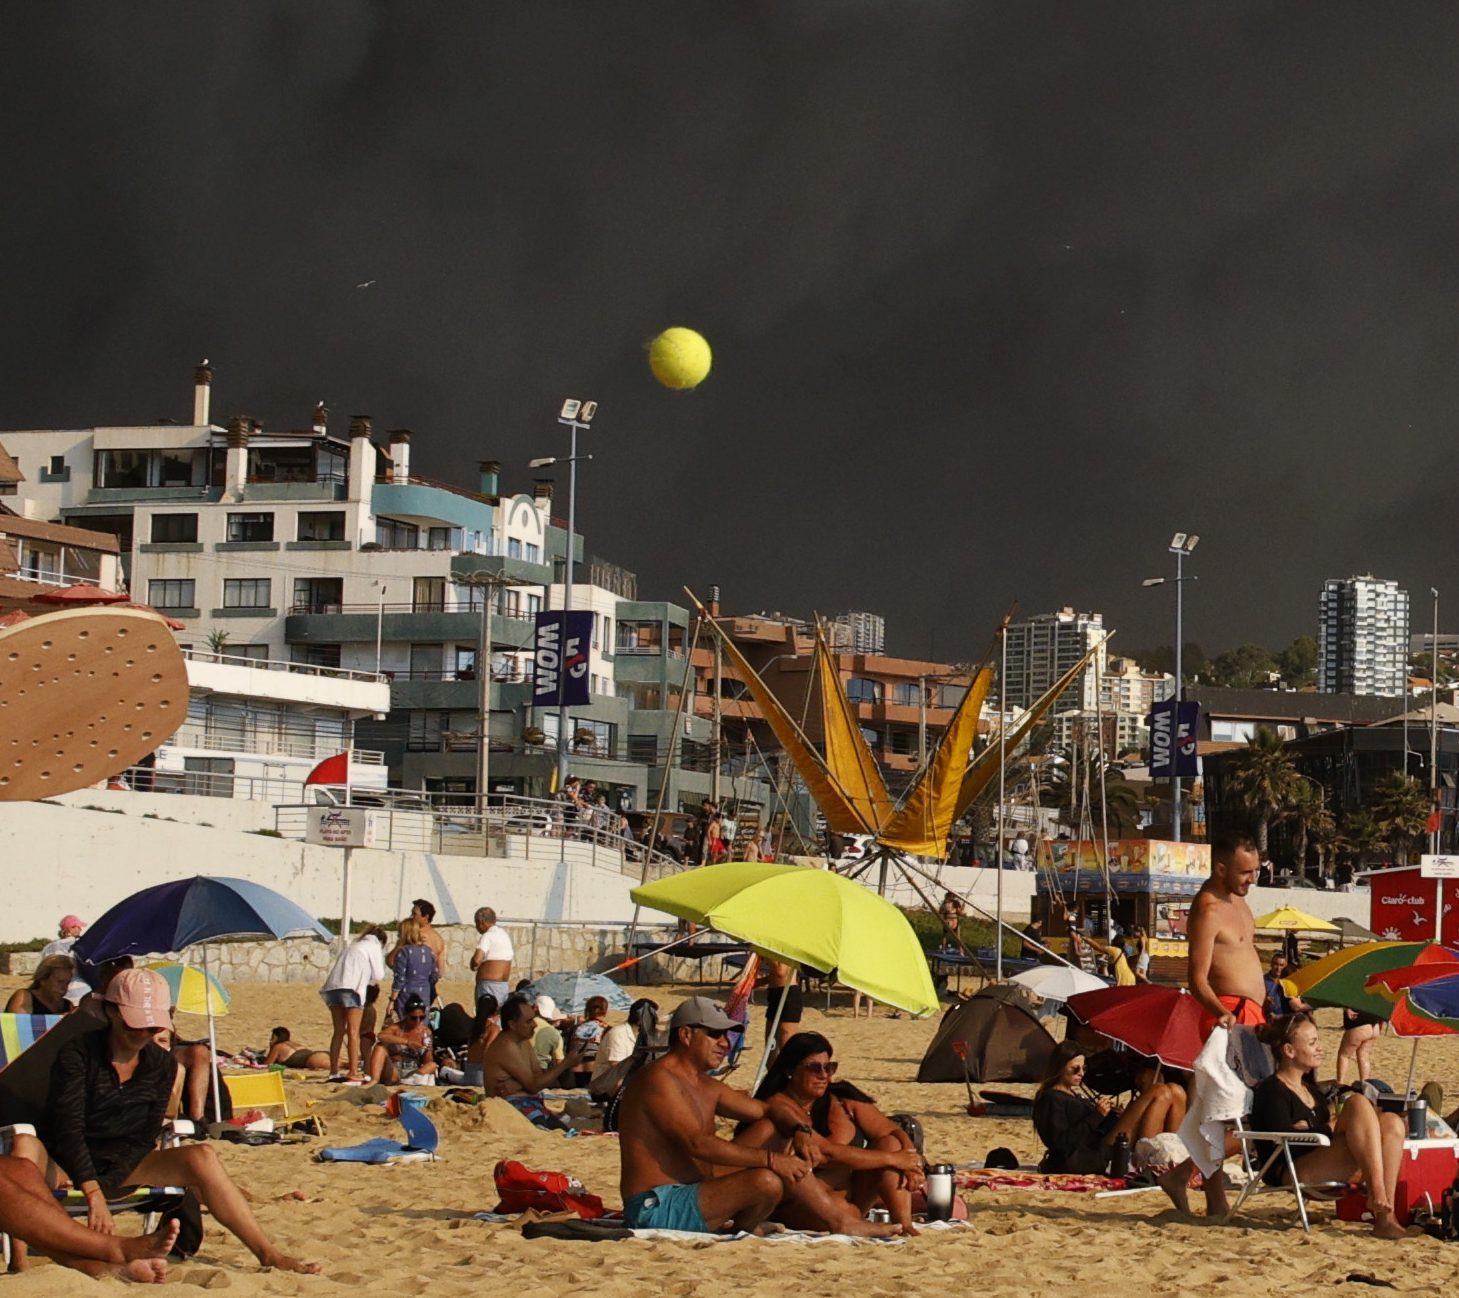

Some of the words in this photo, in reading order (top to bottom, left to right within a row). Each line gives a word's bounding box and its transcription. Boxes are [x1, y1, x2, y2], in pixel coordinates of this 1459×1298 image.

[536, 622, 560, 696] WOM
[565, 637, 587, 679] 5G
[1153, 710, 1171, 768] WOM
[1177, 723, 1195, 756] 5G
